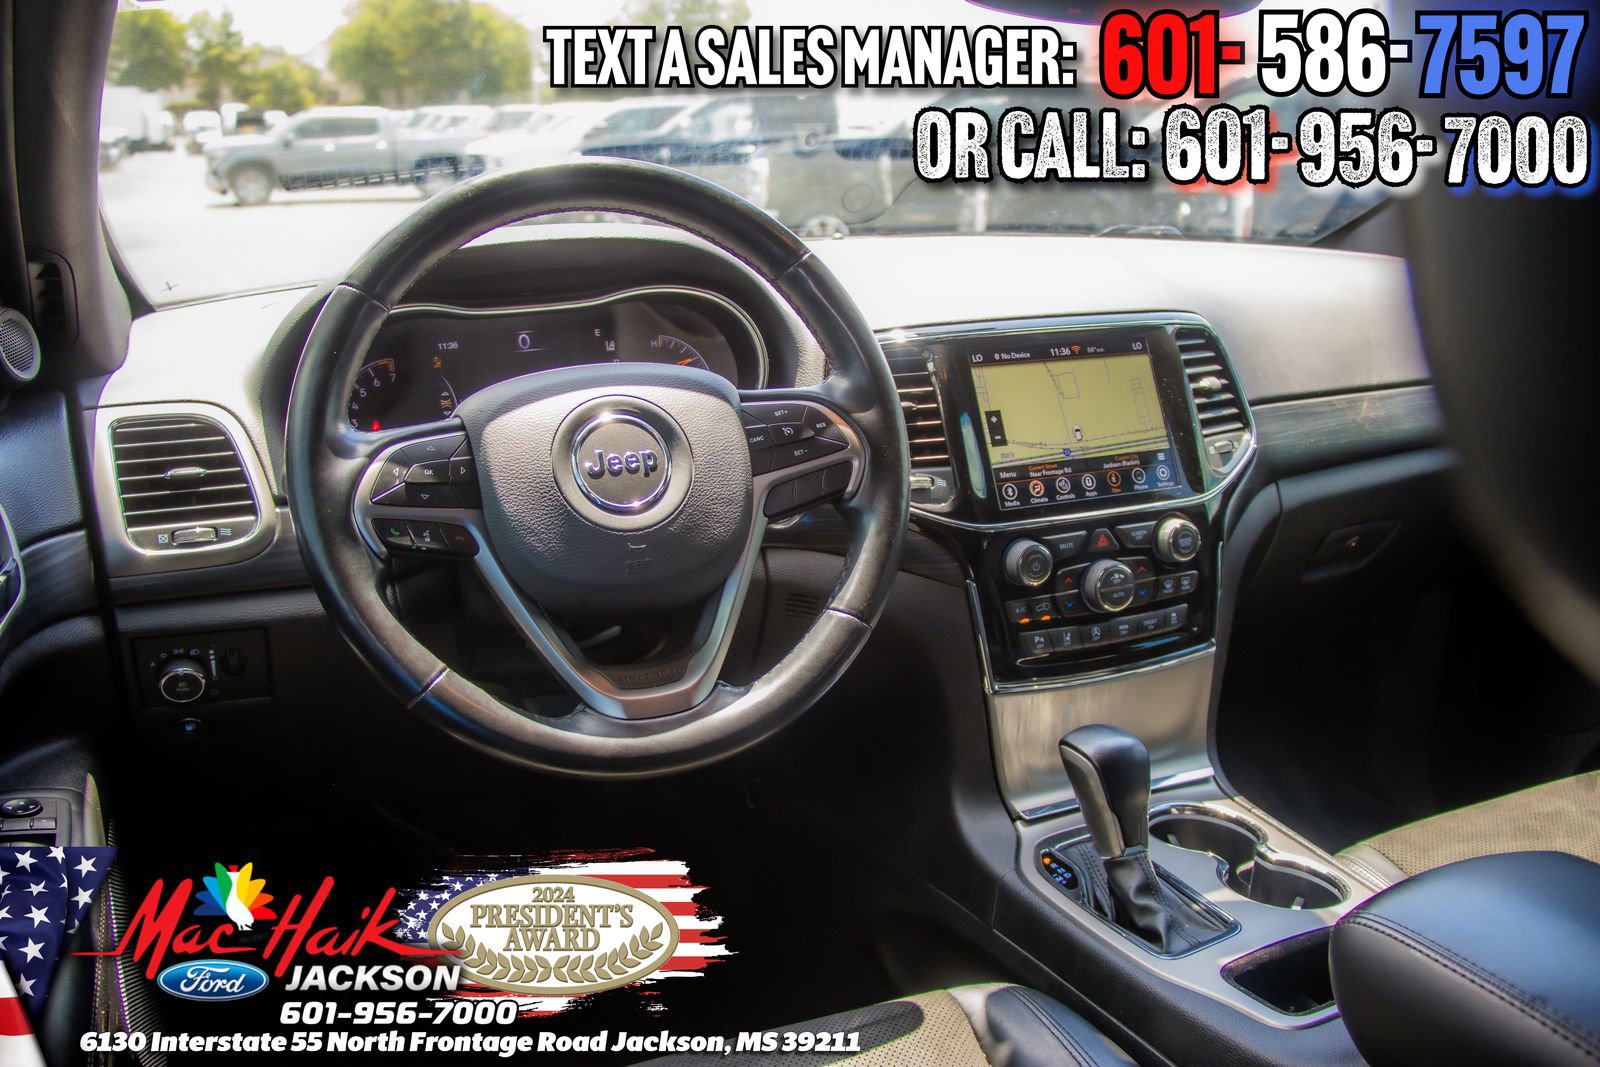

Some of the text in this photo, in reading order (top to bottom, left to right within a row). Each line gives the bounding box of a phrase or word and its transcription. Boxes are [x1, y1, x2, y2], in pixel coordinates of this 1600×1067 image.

[1132, 341, 1143, 350] LO
[1001, 351, 1031, 360] No Device
[1049, 347, 1071, 357] 11:36
[971, 354, 984, 363] LO
[373, 378, 381, 387] 6
[360, 388, 367, 398] 5
[586, 449, 659, 477] Jeep
[1000, 471, 1017, 479] Menu
